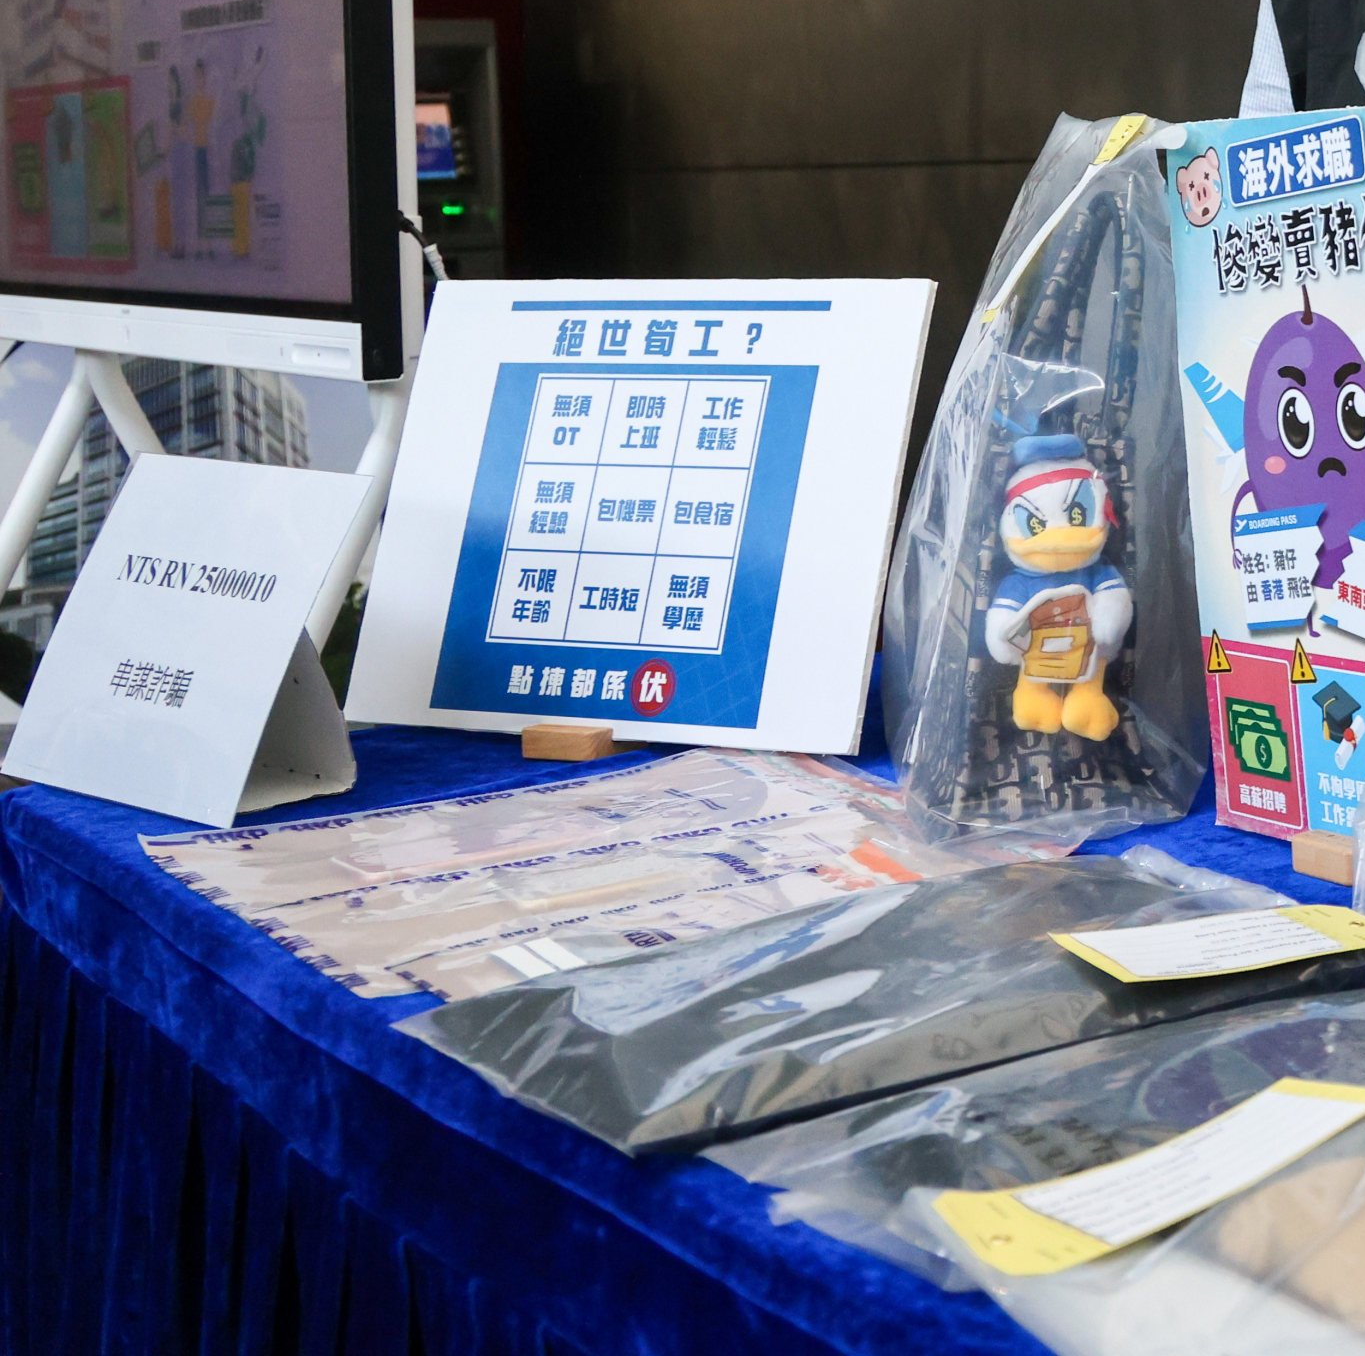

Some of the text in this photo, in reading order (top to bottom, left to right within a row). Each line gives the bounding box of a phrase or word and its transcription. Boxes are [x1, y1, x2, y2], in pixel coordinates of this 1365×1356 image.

[1237, 125, 1355, 201] 海外求職
[551, 394, 744, 421] 無須 即時 工作
[552, 425, 738, 451] OT 上班 輕鬆
[534, 480, 735, 527] 無須 包機票 包食宿
[528, 510, 569, 535] 經驗
[1249, 514, 1298, 531] BOARDING PASS
[117, 554, 278, 603] NTS RN 25000010
[518, 567, 711, 613] 不限 工時短 無須
[1246, 576, 1312, 604] 由 香港 飛往
[511, 598, 705, 632] 年齡 學歷
[110, 658, 195, 708] 串謀詐騙
[1238, 782, 1288, 815] 高薪招聘
